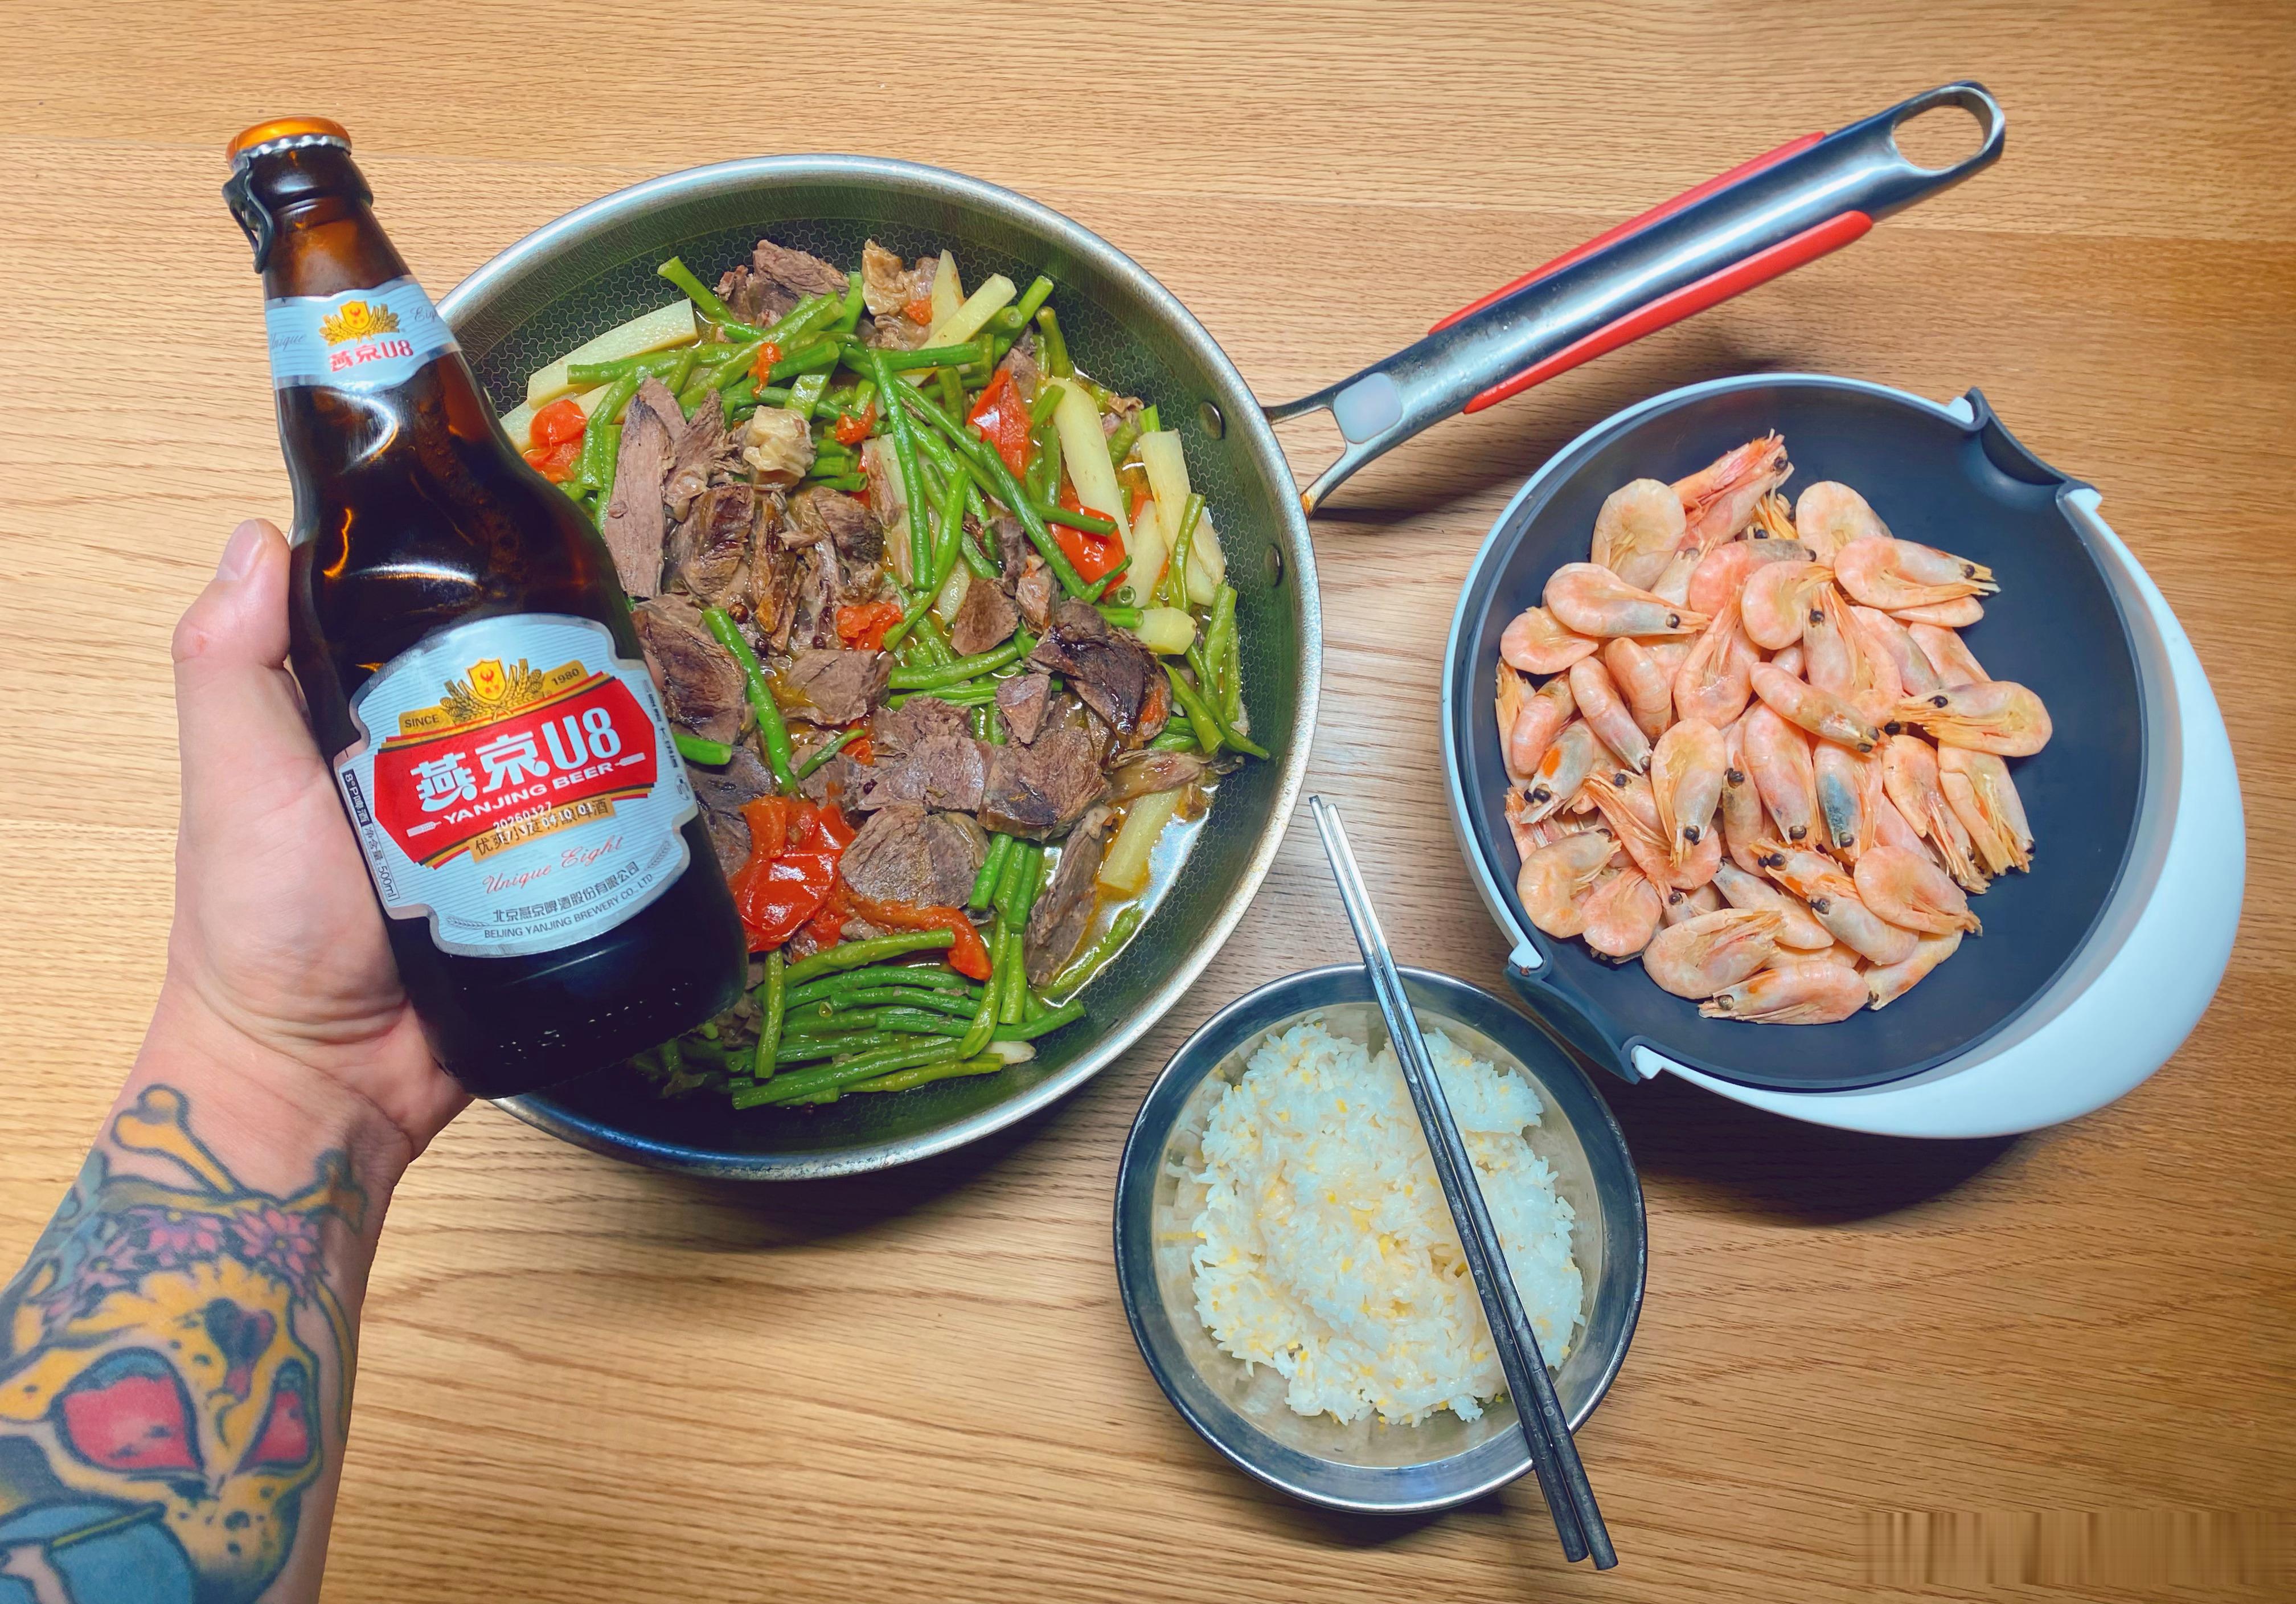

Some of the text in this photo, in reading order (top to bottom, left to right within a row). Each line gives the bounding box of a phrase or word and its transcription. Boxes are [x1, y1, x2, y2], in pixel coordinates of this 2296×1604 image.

[328, 339, 414, 372] 燕京U8
[404, 668, 580, 729] SINCE 1980
[410, 707, 622, 813] 燕京U8
[442, 762, 614, 824] YANJING BEER
[493, 801, 552, 832] 20260327
[482, 834, 624, 894] Unique Eight
[493, 861, 640, 923] 北京燕京啤酒股份有限公司
[485, 928, 523, 938] BEIJING
[525, 916, 572, 935] YANJING
[575, 895, 620, 922] BREWERY
[638, 873, 653, 889] LTD
